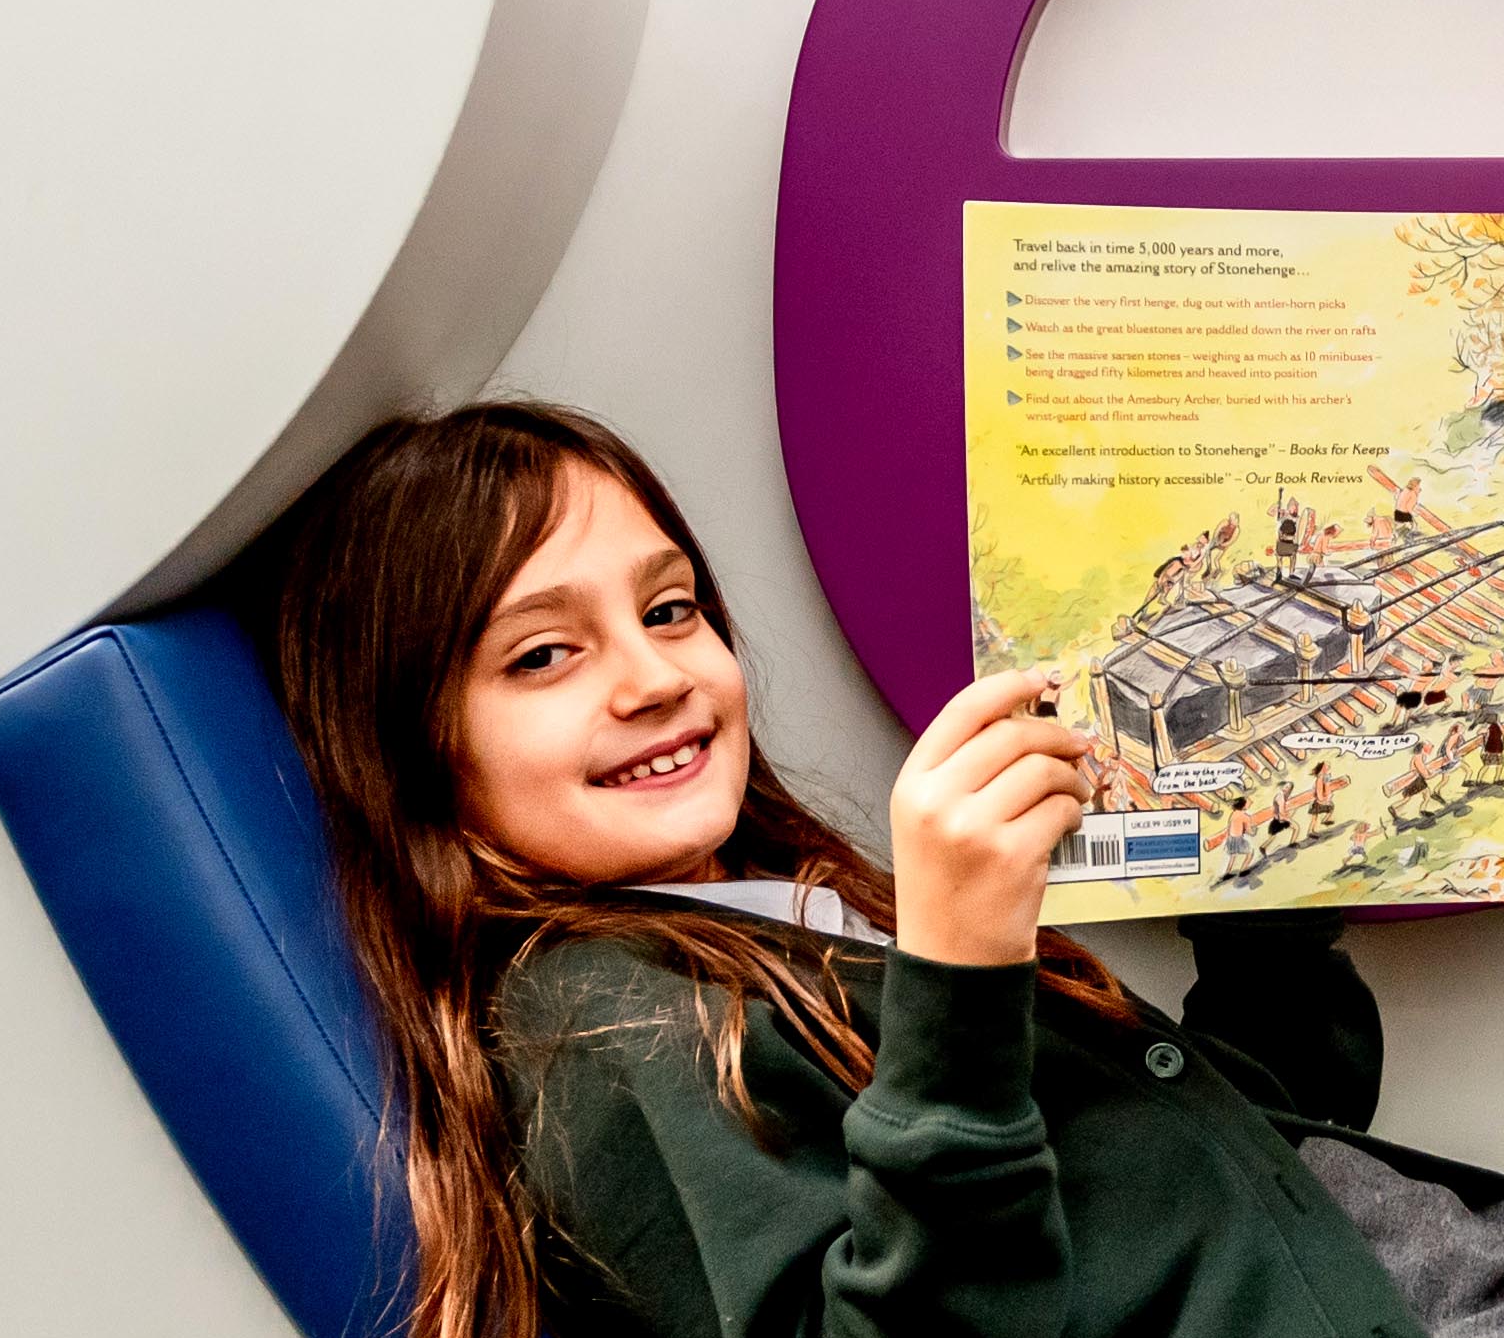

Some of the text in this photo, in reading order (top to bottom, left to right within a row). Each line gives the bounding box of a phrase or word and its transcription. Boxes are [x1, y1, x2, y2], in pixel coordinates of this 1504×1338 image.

[1013, 239, 1284, 258] Travel back in time 5,000 years and more,
[1013, 259, 1037, 271] and
[1041, 259, 1076, 272] relive
[1081, 260, 1101, 272] the
[1106, 262, 1160, 276] amazing
[1163, 263, 1196, 276] story
[1200, 262, 1216, 275] of
[1025, 294, 1346, 311] Discover the very first henge, dug out with antler-horn picks
[1025, 321, 1376, 336] Watch as the great bluestones are paddled down the river on rafts
[1025, 349, 1044, 360] See
[1048, 350, 1065, 360] the
[1068, 351, 1108, 360] massive
[1112, 352, 1144, 361] sarsen
[1147, 351, 1181, 361] stones
[1192, 352, 1240, 363] weighing
[1244, 353, 1254, 361] as
[1257, 352, 1287, 361] much
[1290, 353, 1301, 361] as
[1305, 351, 1316, 361] 10
[1319, 351, 1373, 362] minibuses
[1025, 366, 1317, 380] being dragged fifty kilometres and heaved into position
[1025, 393, 1352, 406] Find out about the Amesbury Archer, buried with his archer's
[1025, 411, 1199, 423] wrist-guard and flint arrowheads
[1042, 445, 1096, 456] excellent
[1100, 445, 1174, 456] introduction
[1178, 446, 1191, 456] to
[1290, 444, 1327, 456] Books
[1331, 444, 1349, 456] for
[1352, 444, 1390, 457] Keeps
[1071, 474, 1115, 488] making
[1119, 473, 1160, 487] history
[1246, 472, 1271, 484] Our
[1275, 472, 1307, 484] Book
[1311, 471, 1362, 484] Reviews
